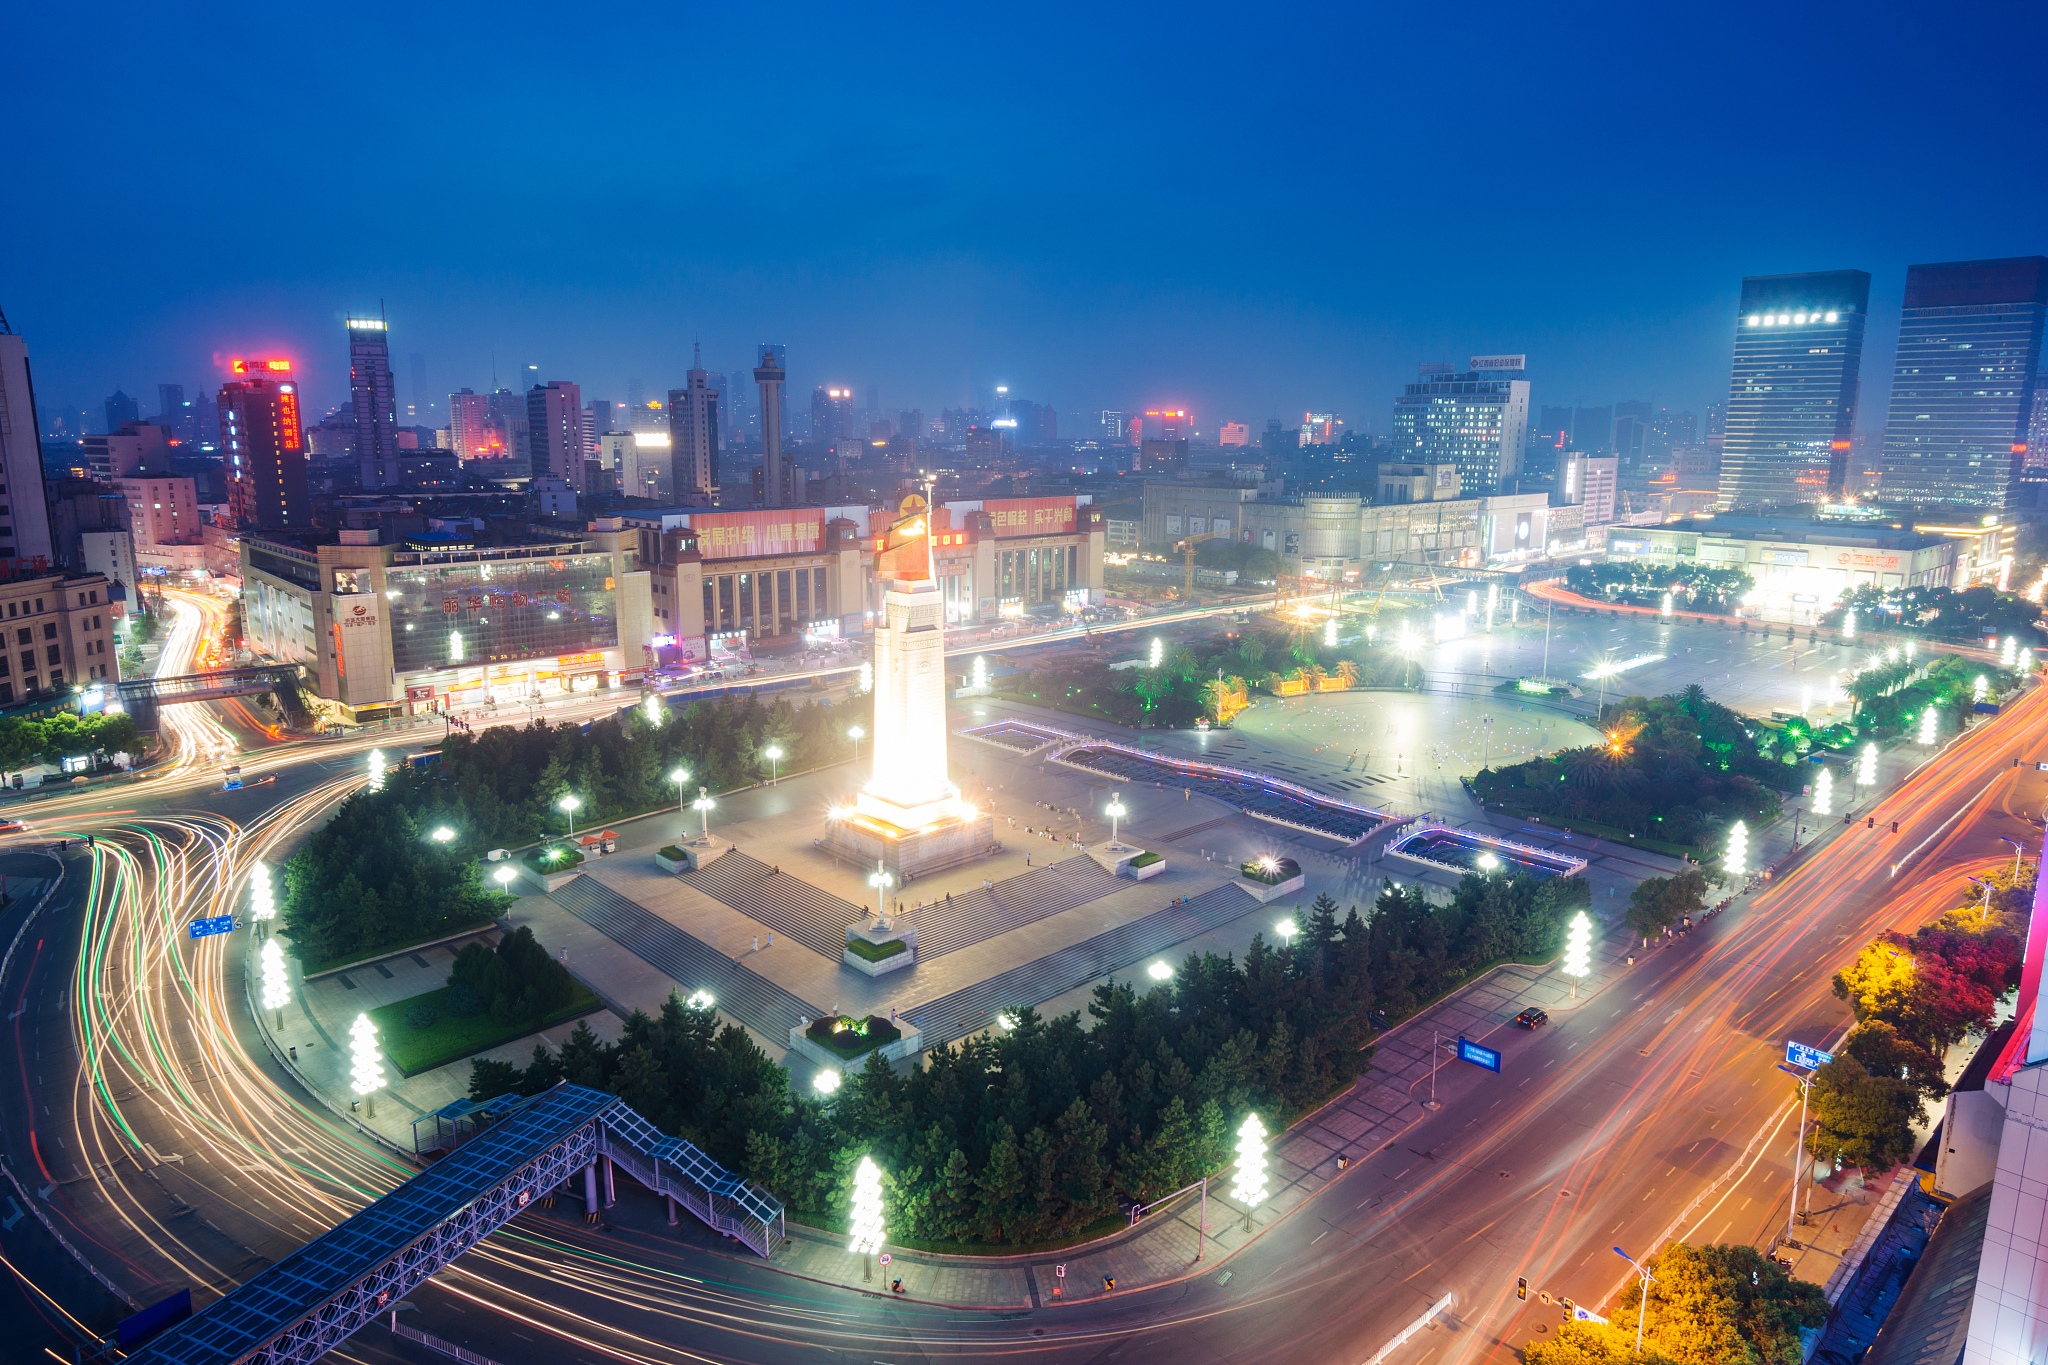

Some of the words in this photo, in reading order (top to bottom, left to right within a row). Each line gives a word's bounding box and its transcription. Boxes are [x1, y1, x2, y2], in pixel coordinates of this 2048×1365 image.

[698, 525, 755, 547] 发展升级
[766, 522, 820, 542] 小康提速
[1775, 553, 1806, 563] IMAX
[443, 588, 571, 613] 丽华购物广场
